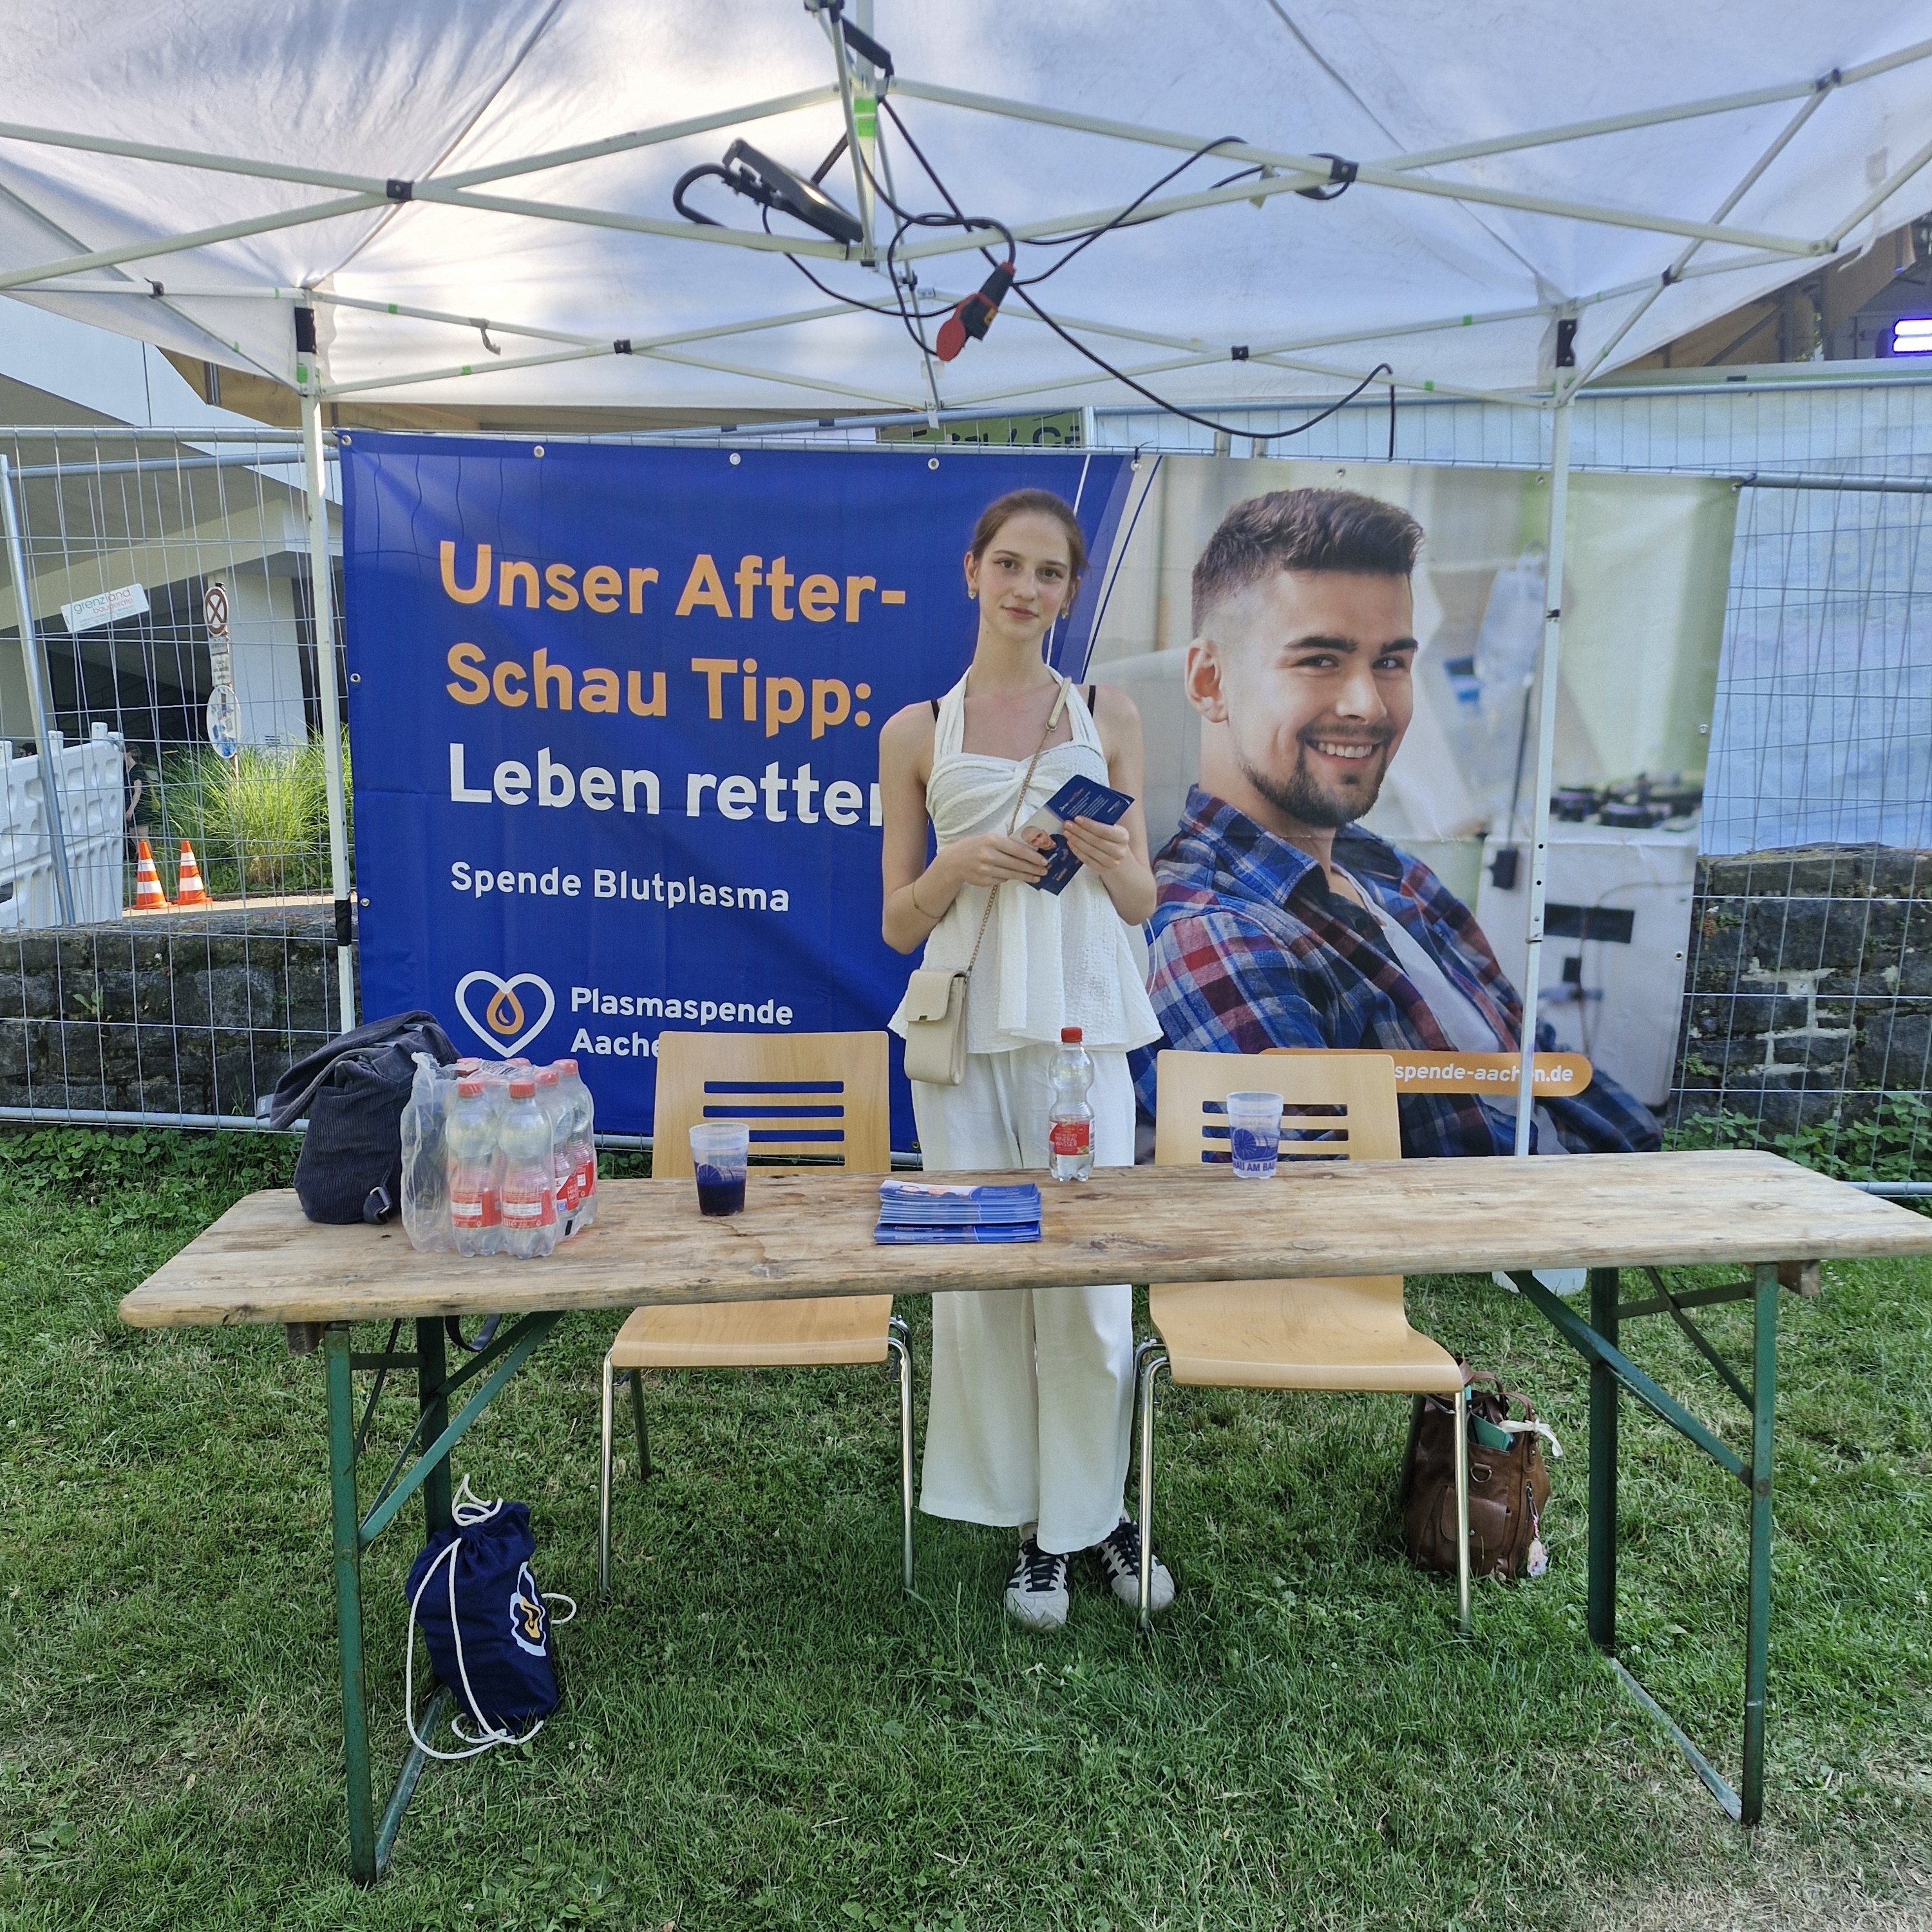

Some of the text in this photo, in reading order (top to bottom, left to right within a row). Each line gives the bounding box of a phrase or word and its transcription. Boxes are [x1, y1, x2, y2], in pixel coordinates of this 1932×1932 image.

[73, 587, 131, 614] grenzland
[440, 540, 906, 623] Unser After-
[446, 643, 871, 739] Schau Tipp:
[450, 743, 660, 815] Leben
[451, 861, 790, 912] Spende Blutplasma
[571, 987, 793, 1026] Plasmaspende
[1395, 1064, 1573, 1082] spende-aachn.de
[1247, 1163, 1260, 1171] AM
